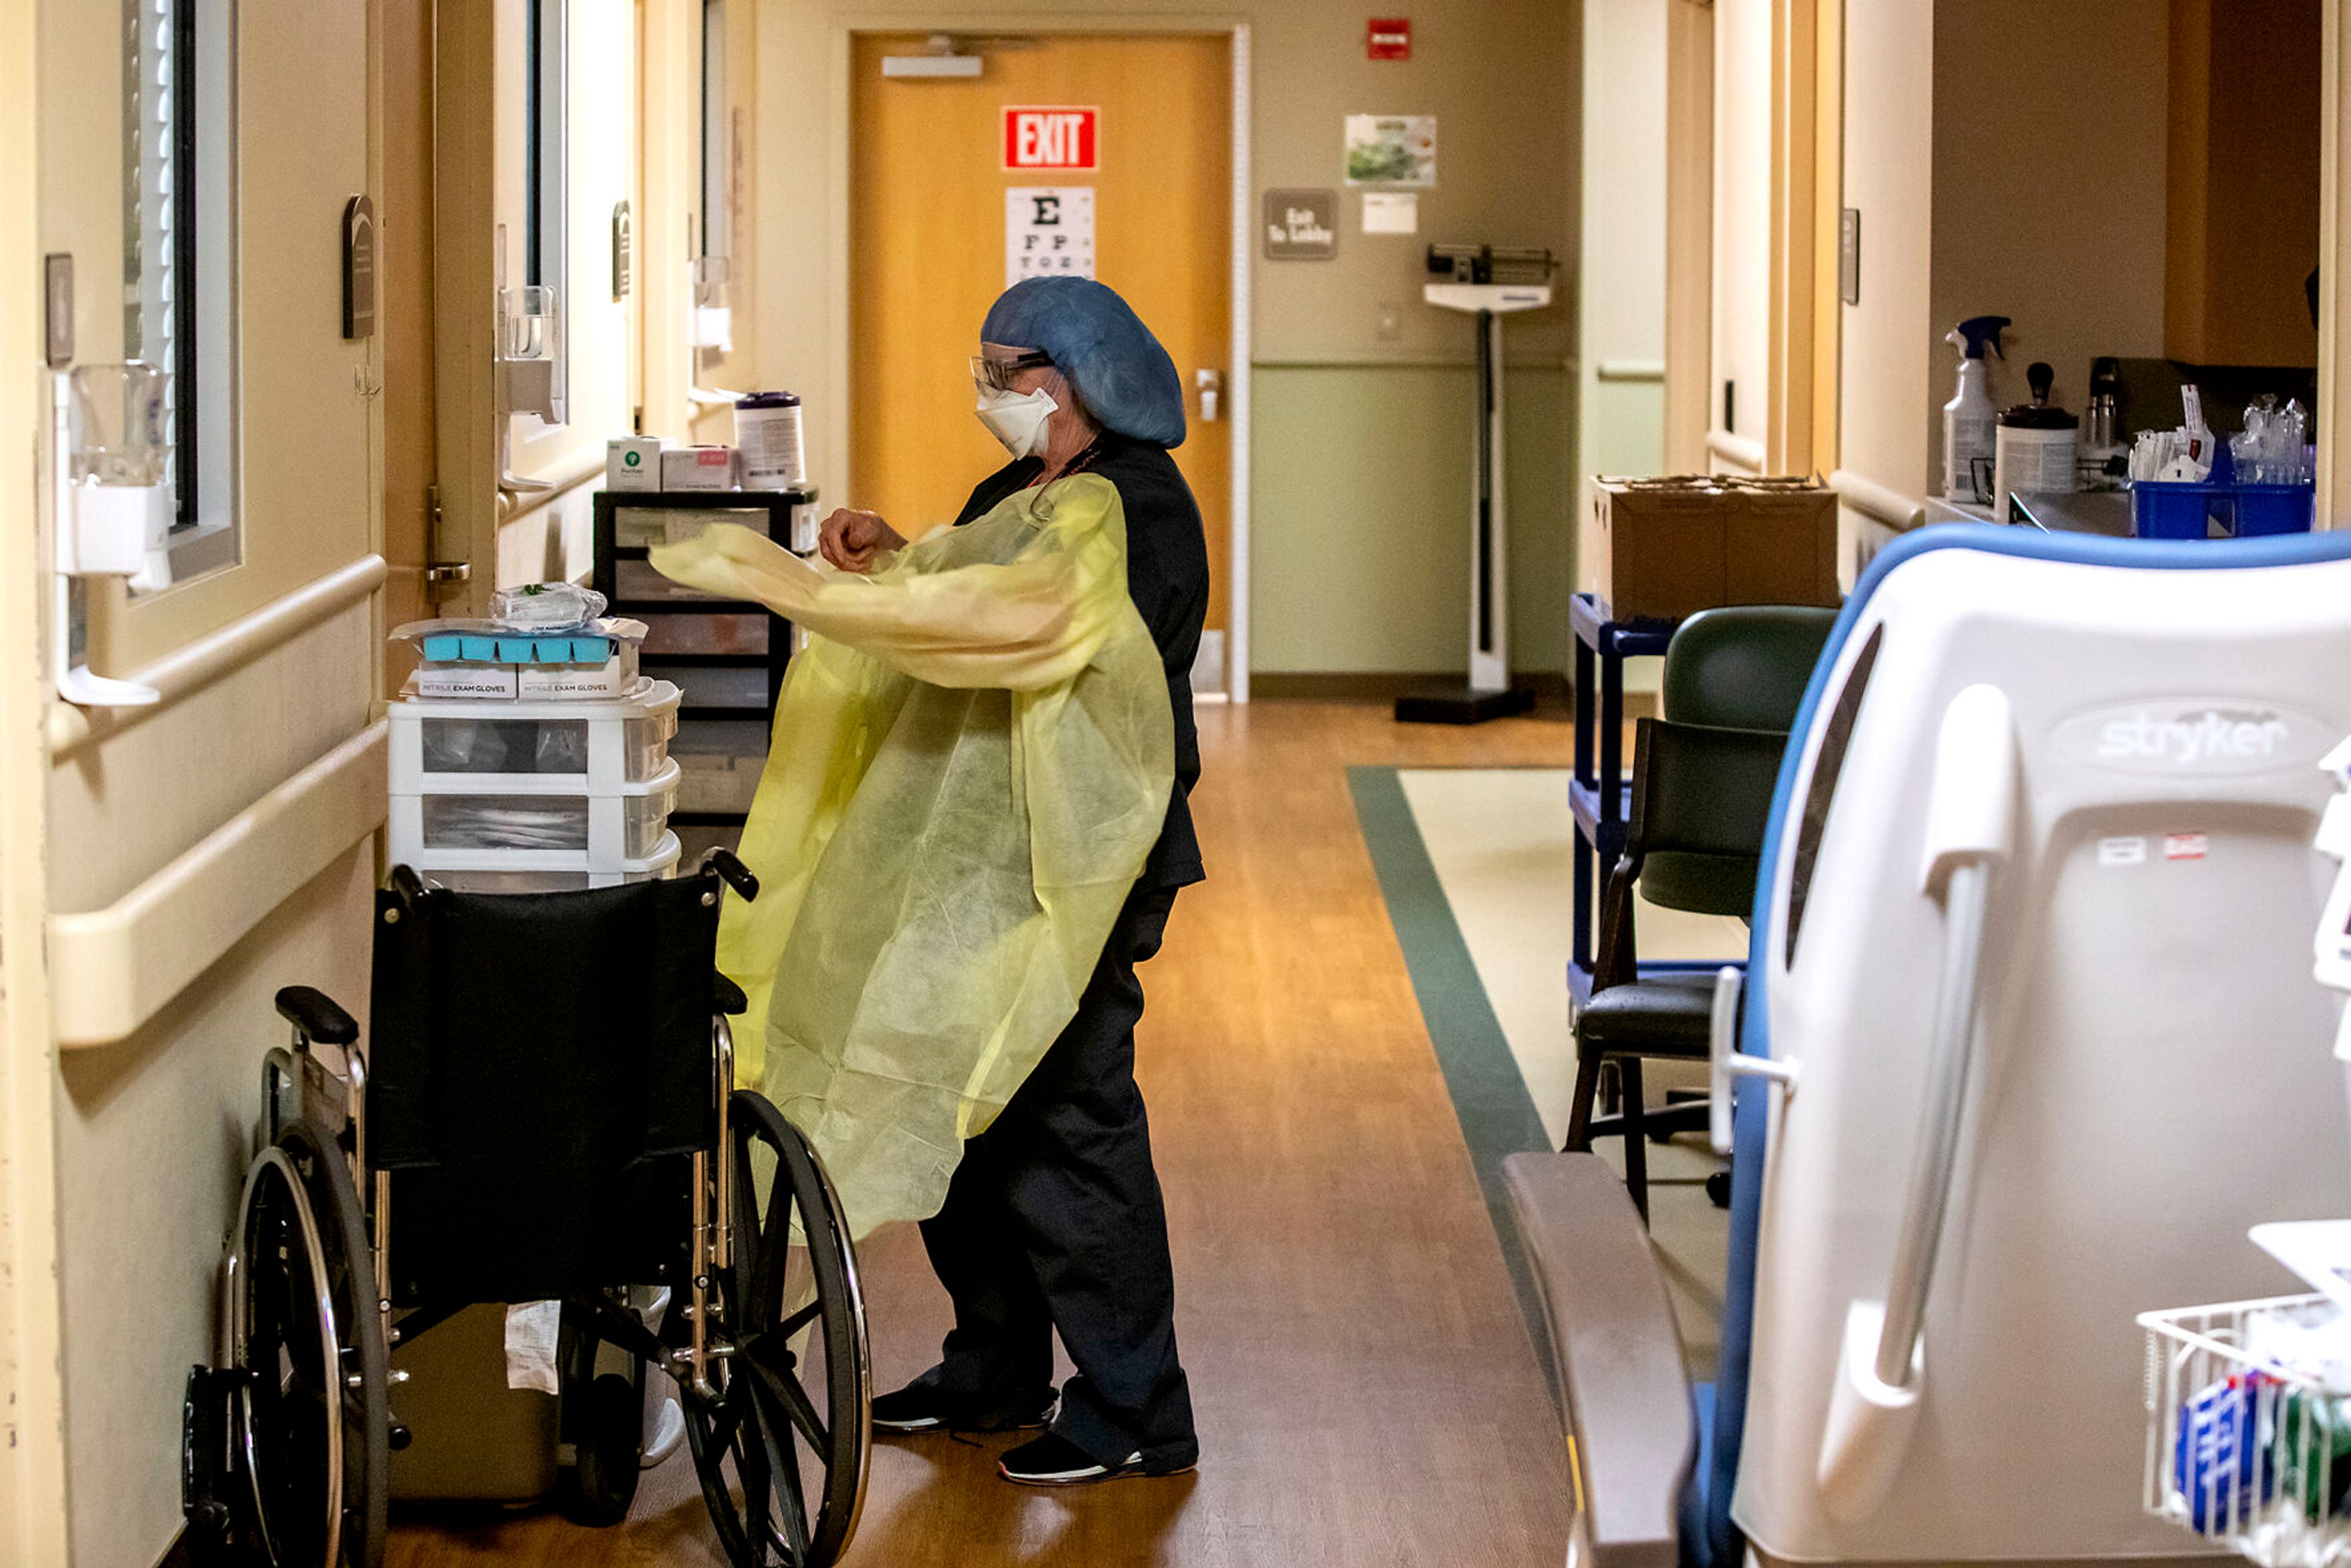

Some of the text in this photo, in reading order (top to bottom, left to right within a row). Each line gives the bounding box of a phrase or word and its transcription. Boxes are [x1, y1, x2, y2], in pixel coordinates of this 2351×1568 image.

[1017, 113, 1085, 165] EXIT
[1032, 196, 1060, 225] E
[1286, 208, 1314, 224] Exit
[1025, 234, 1068, 250] F P
[476, 685, 506, 693] GLOVES
[2097, 711, 2289, 763] stryker
